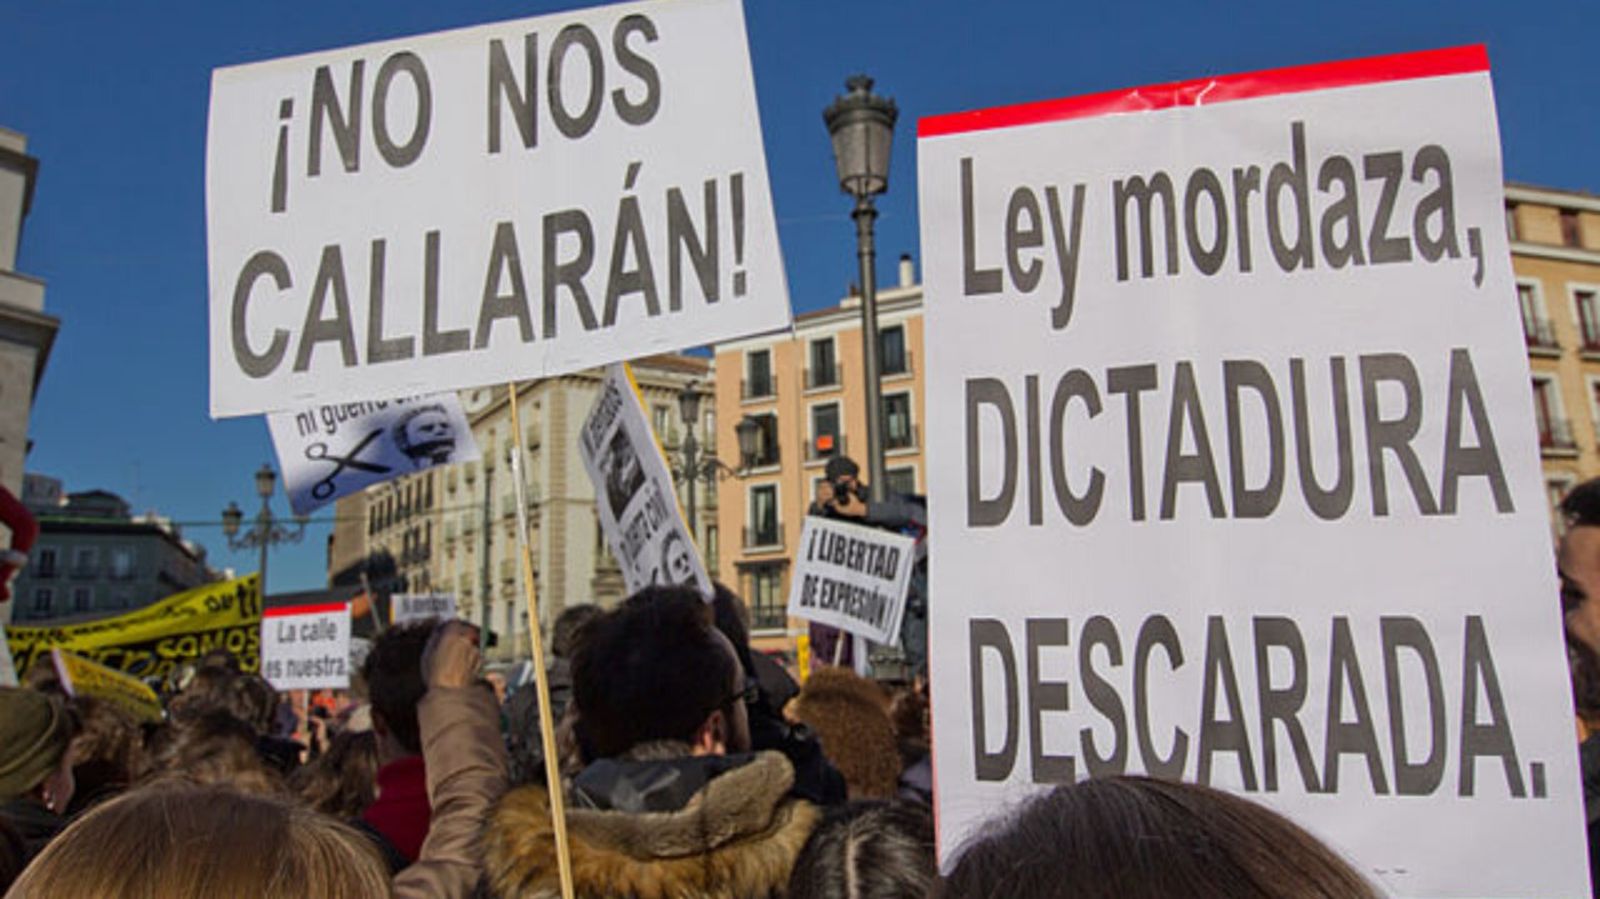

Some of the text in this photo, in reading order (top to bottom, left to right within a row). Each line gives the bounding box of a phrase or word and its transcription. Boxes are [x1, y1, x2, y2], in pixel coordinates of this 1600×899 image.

[270, 13, 662, 213] ¡NO NOS
[230, 161, 749, 379] CALLARÁN!
[959, 120, 1486, 331] Ley mordaza,
[296, 409, 318, 437] ni
[964, 347, 1517, 528] DICTADURA
[266, 659, 282, 679] es
[277, 617, 338, 643] La calle
[800, 573, 819, 608] DE
[968, 613, 1548, 799] DESCARADA.
